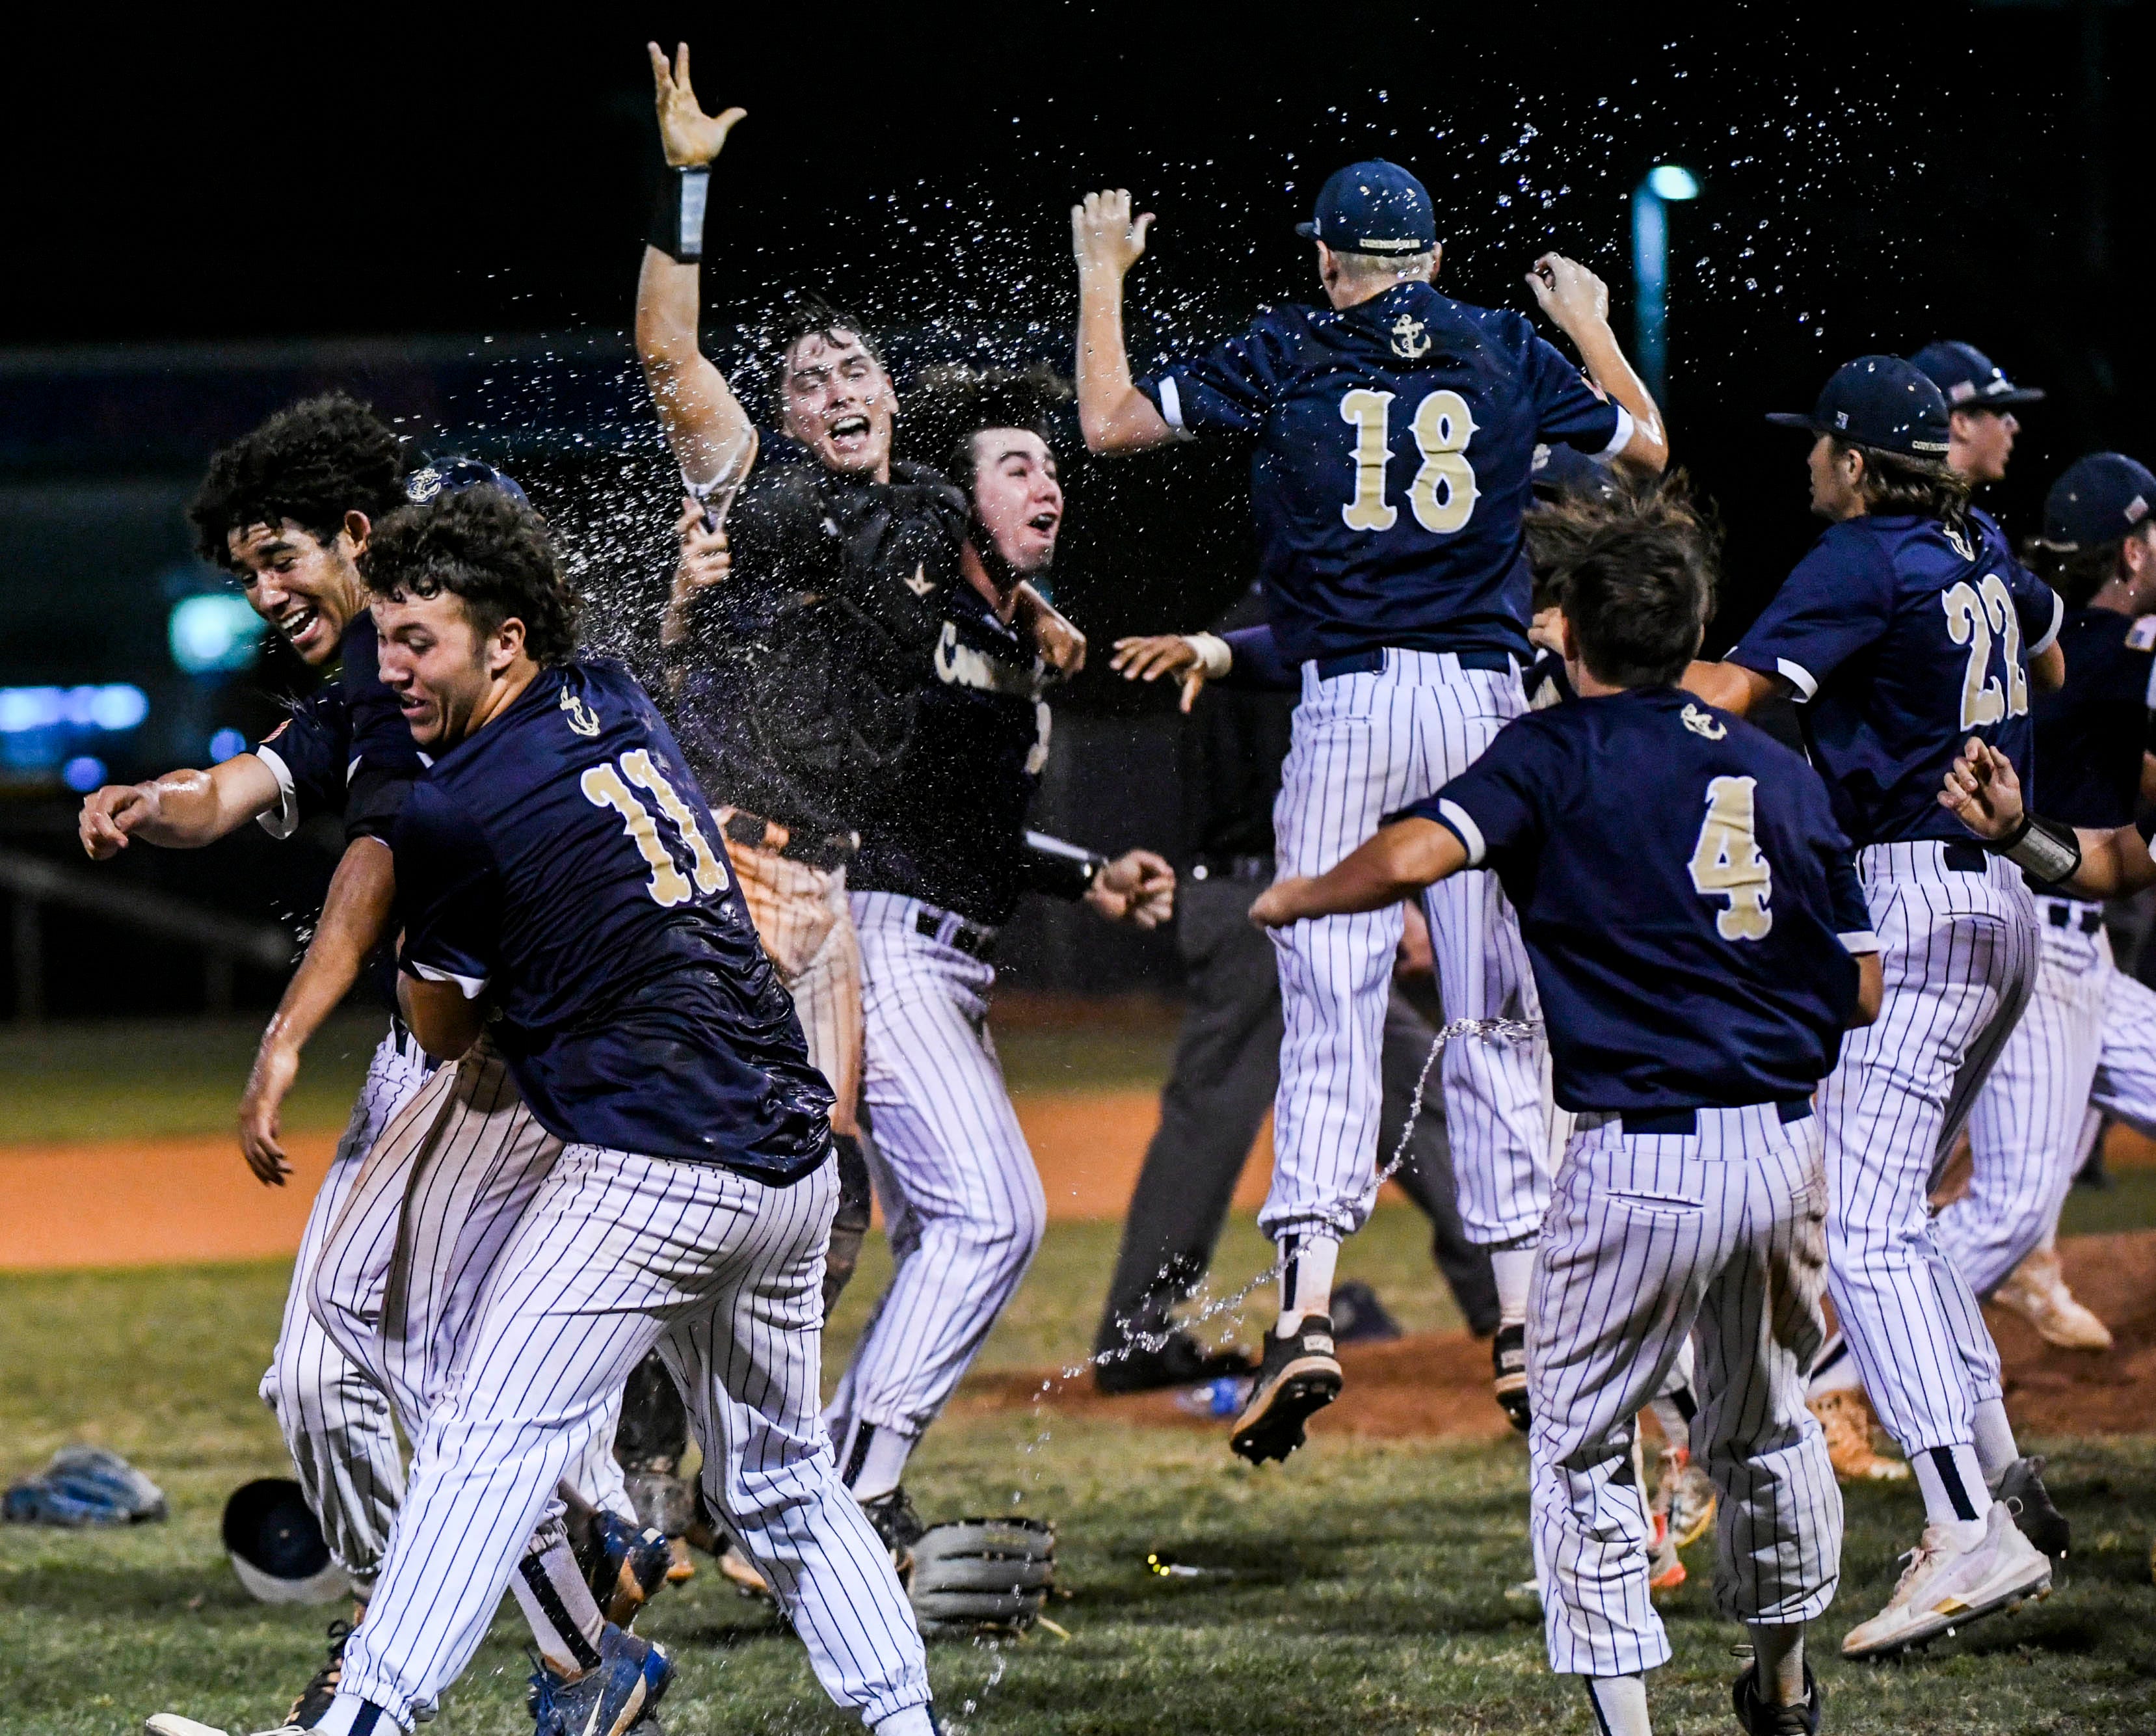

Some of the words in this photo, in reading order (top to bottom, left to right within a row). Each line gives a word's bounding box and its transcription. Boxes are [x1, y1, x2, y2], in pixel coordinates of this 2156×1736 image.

[1340, 388, 1481, 534] 18
[1941, 574, 2028, 732] 22
[581, 749, 730, 908] 11
[1687, 775, 1773, 942] 4
